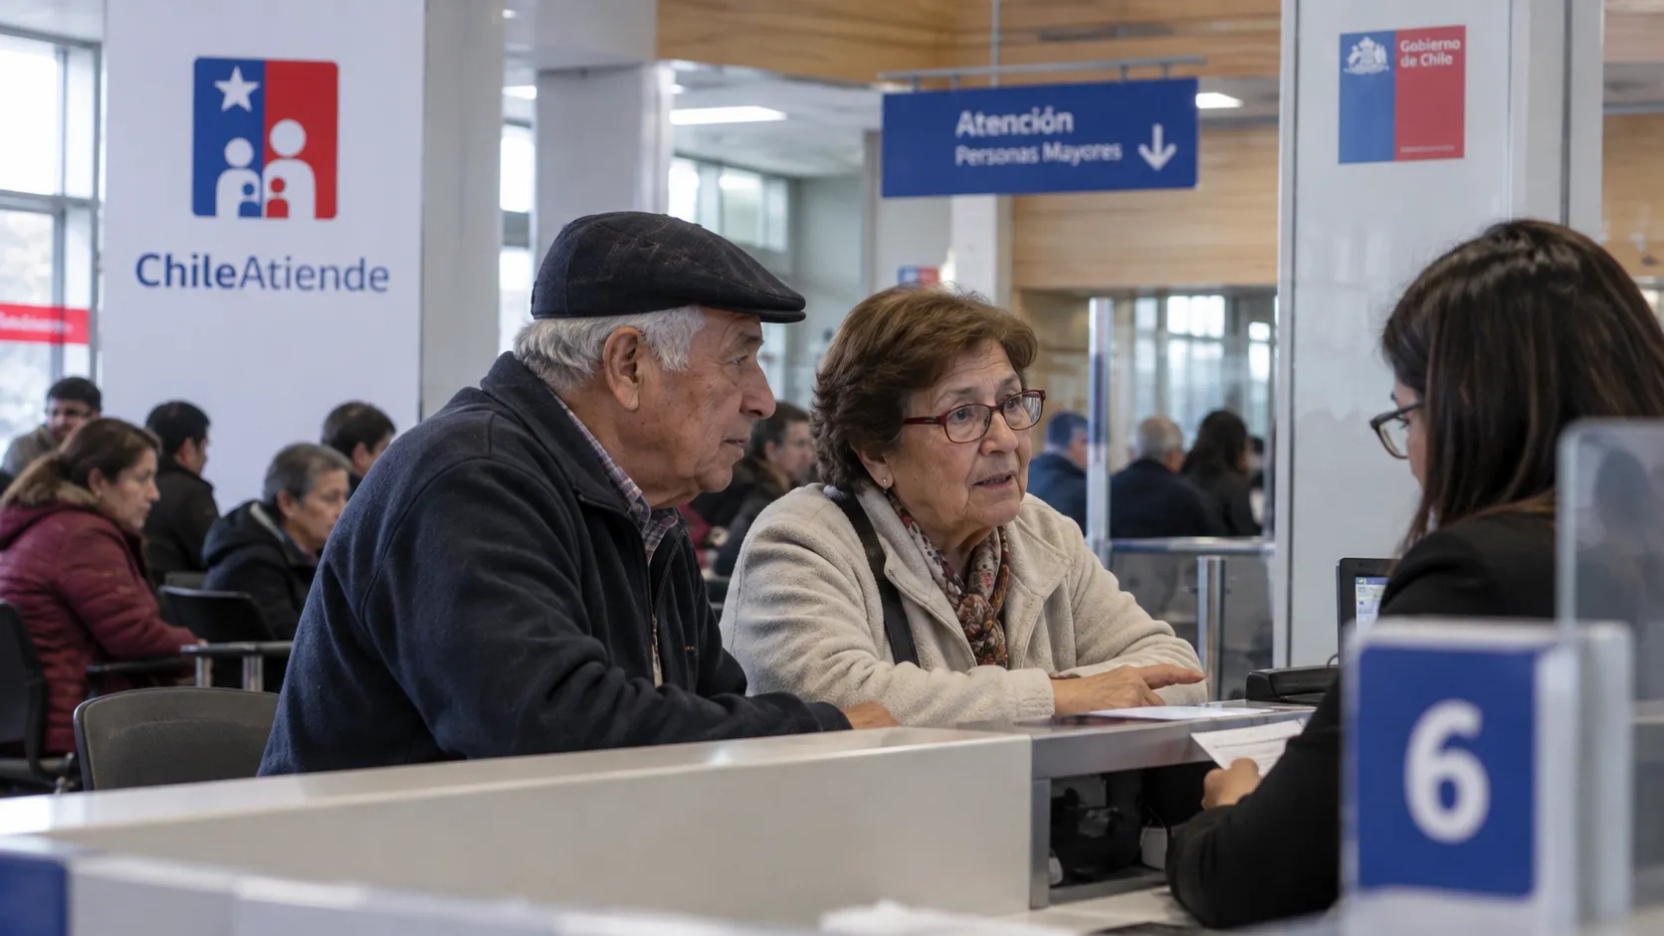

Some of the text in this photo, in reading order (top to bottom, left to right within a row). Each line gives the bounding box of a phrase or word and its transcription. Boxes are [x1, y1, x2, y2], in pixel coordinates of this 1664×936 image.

[1400, 38, 1460, 52] Gobierno
[1400, 52, 1453, 68] de Chile
[955, 106, 1074, 138] Atención
[955, 141, 1122, 167] Personas Mayores
[135, 252, 390, 293] ChileAtiende
[1404, 698, 1491, 845] 6
